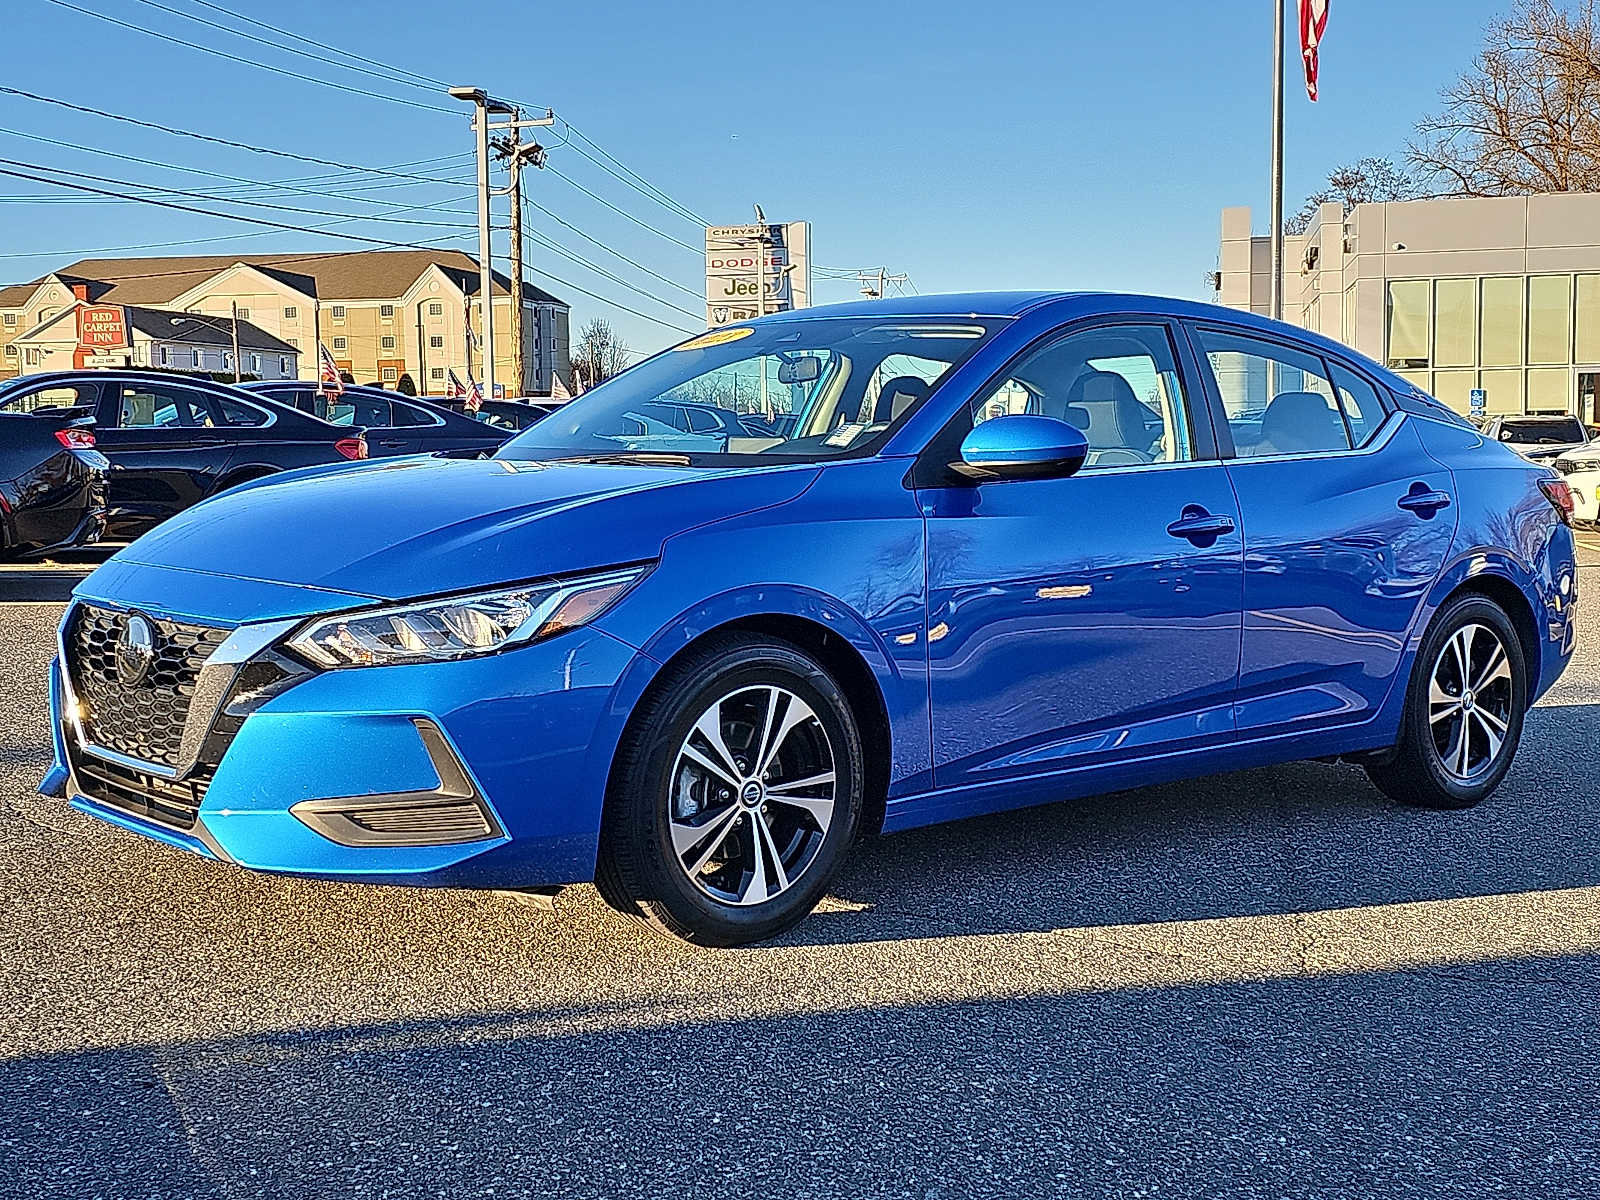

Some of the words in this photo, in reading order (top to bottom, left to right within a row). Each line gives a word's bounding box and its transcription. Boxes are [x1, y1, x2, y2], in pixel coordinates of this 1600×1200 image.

[711, 257, 783, 268] DODGE
[724, 280, 771, 296] Jeep
[92, 312, 113, 322] RED
[733, 310, 762, 320] RA
[84, 323, 120, 332] CARPET
[93, 333, 113, 342] INN
